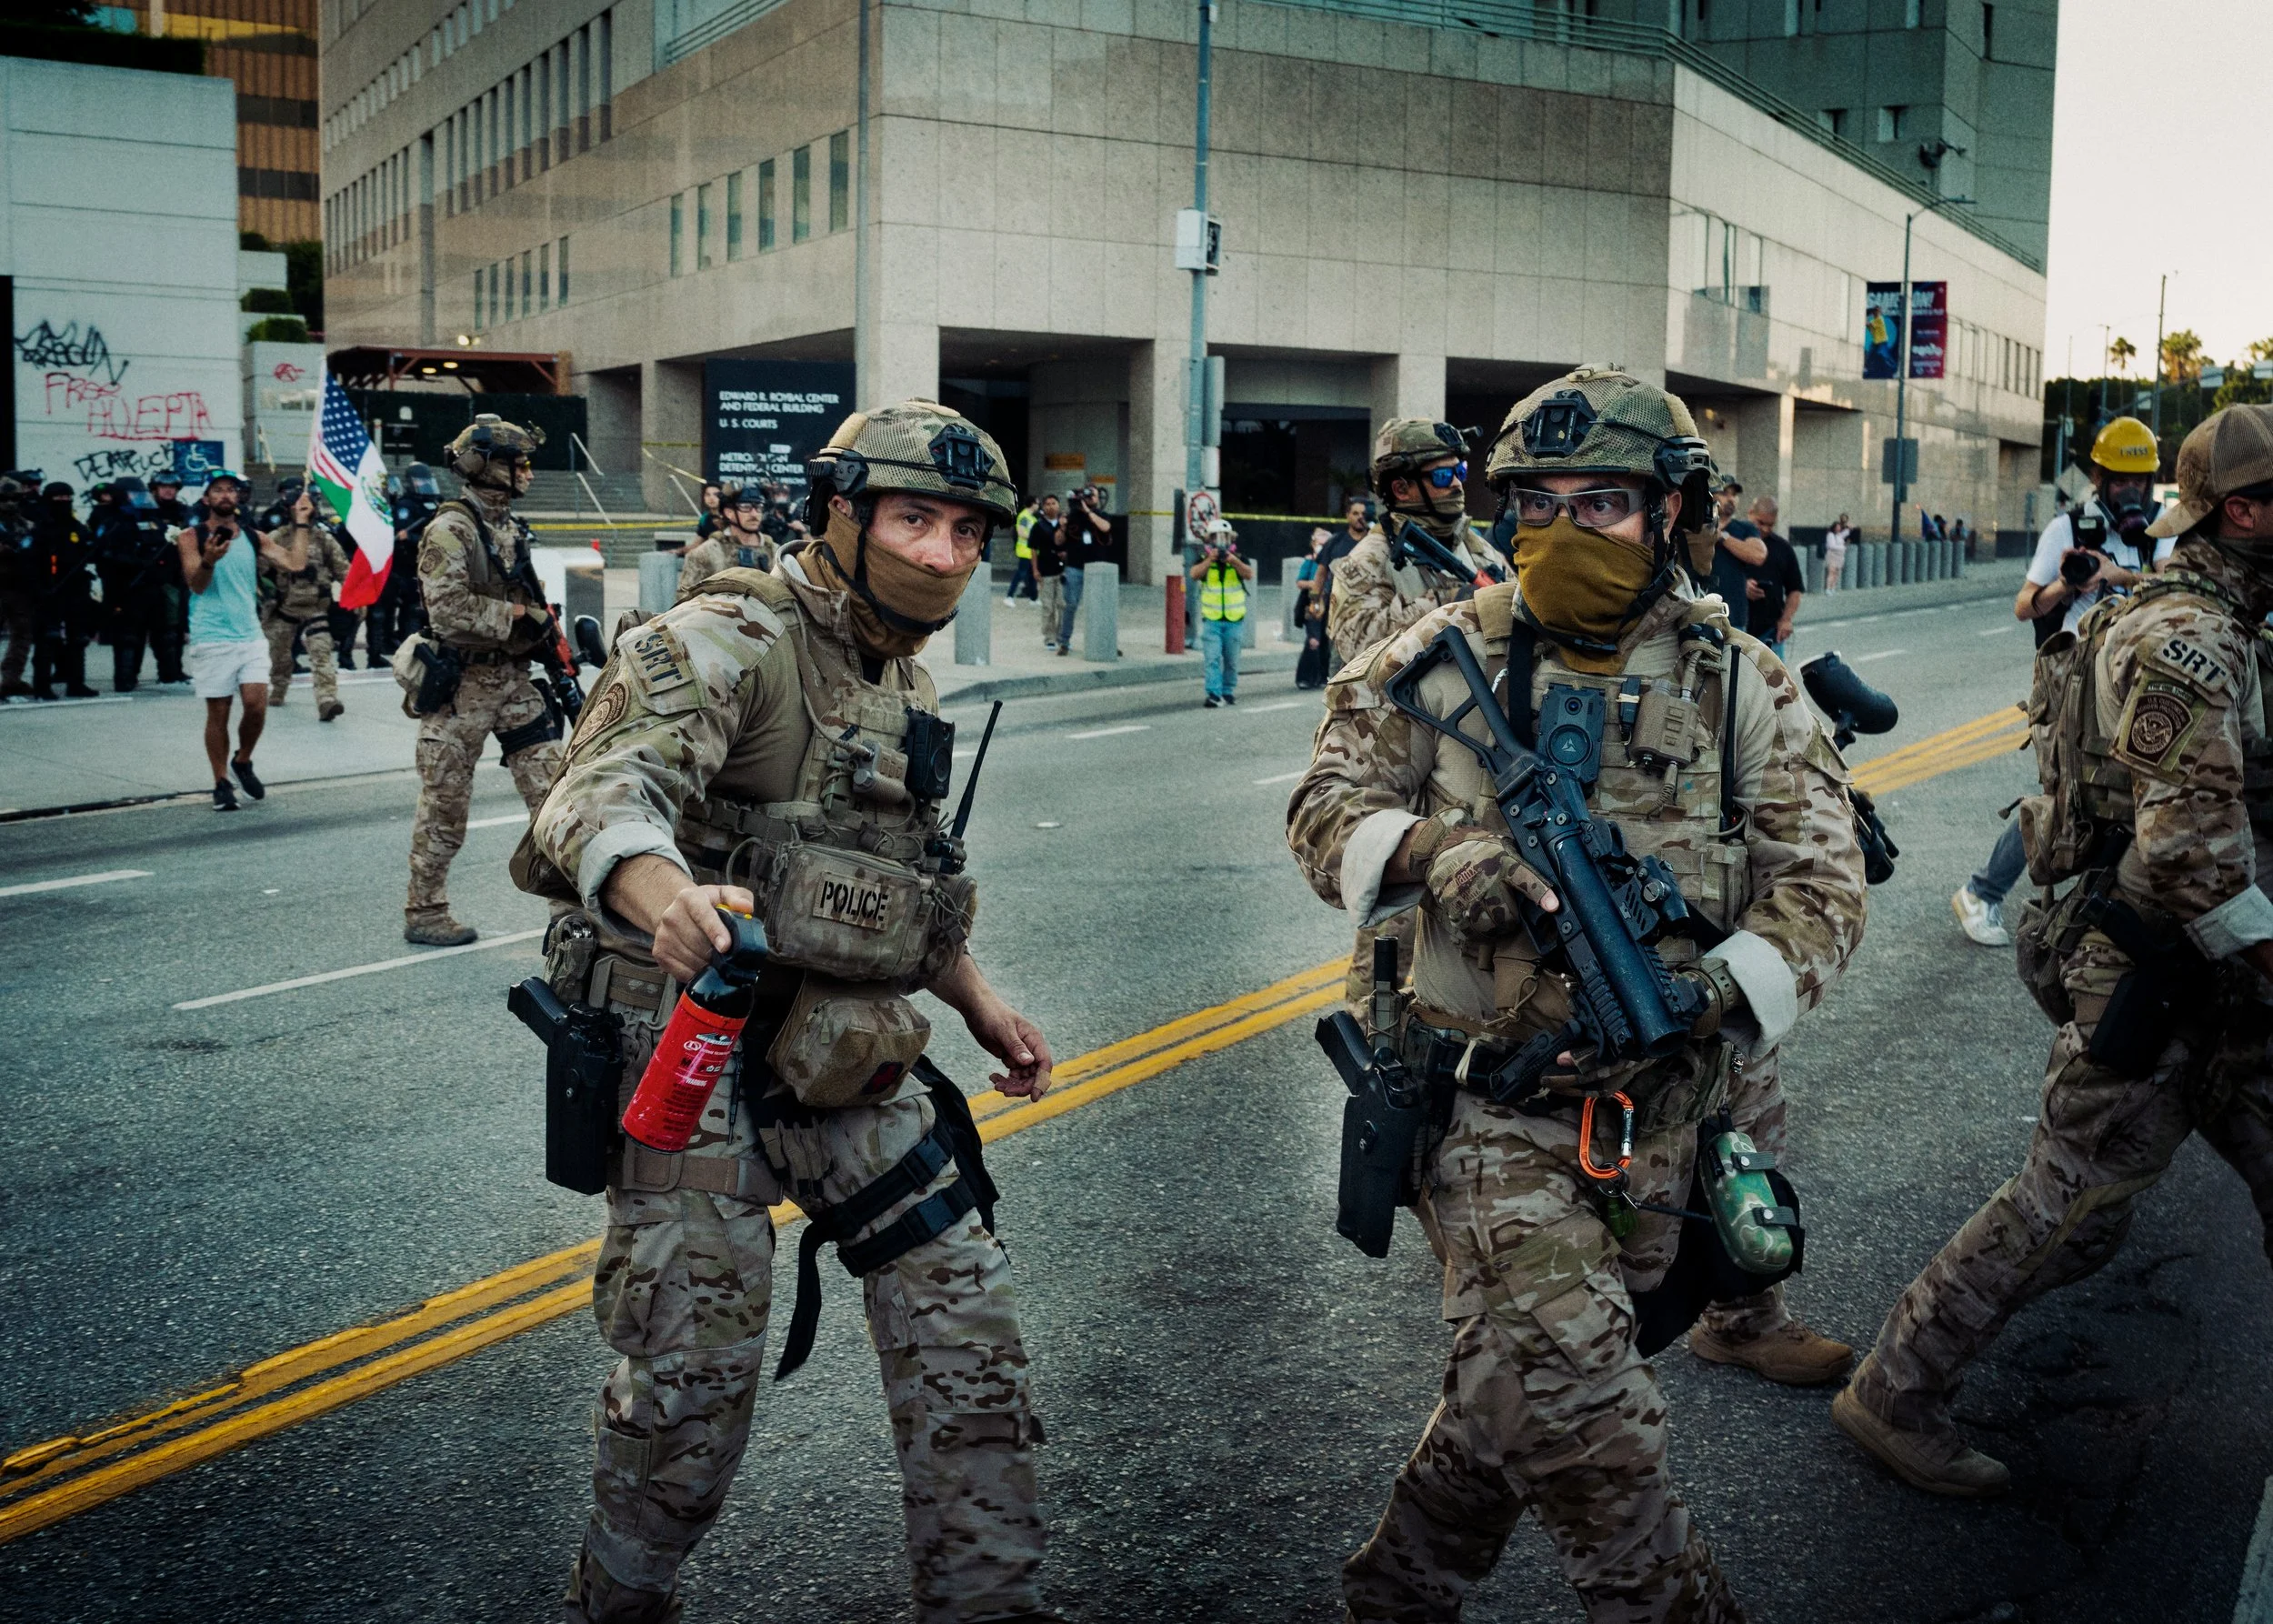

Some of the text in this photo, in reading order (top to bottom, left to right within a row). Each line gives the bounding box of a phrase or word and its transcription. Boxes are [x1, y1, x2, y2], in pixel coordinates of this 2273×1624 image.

[719, 391, 757, 401] EDWARD
[769, 392, 805, 403] ROYBAL
[806, 393, 839, 404] CENTER
[720, 402, 825, 414] AND FEDERAL BUILDING
[742, 419, 778, 429] COURTS
[771, 464, 804, 475] CENTER
[635, 633, 682, 683] SRT
[2163, 639, 2227, 683] SRT
[820, 880, 888, 921] POLICE
